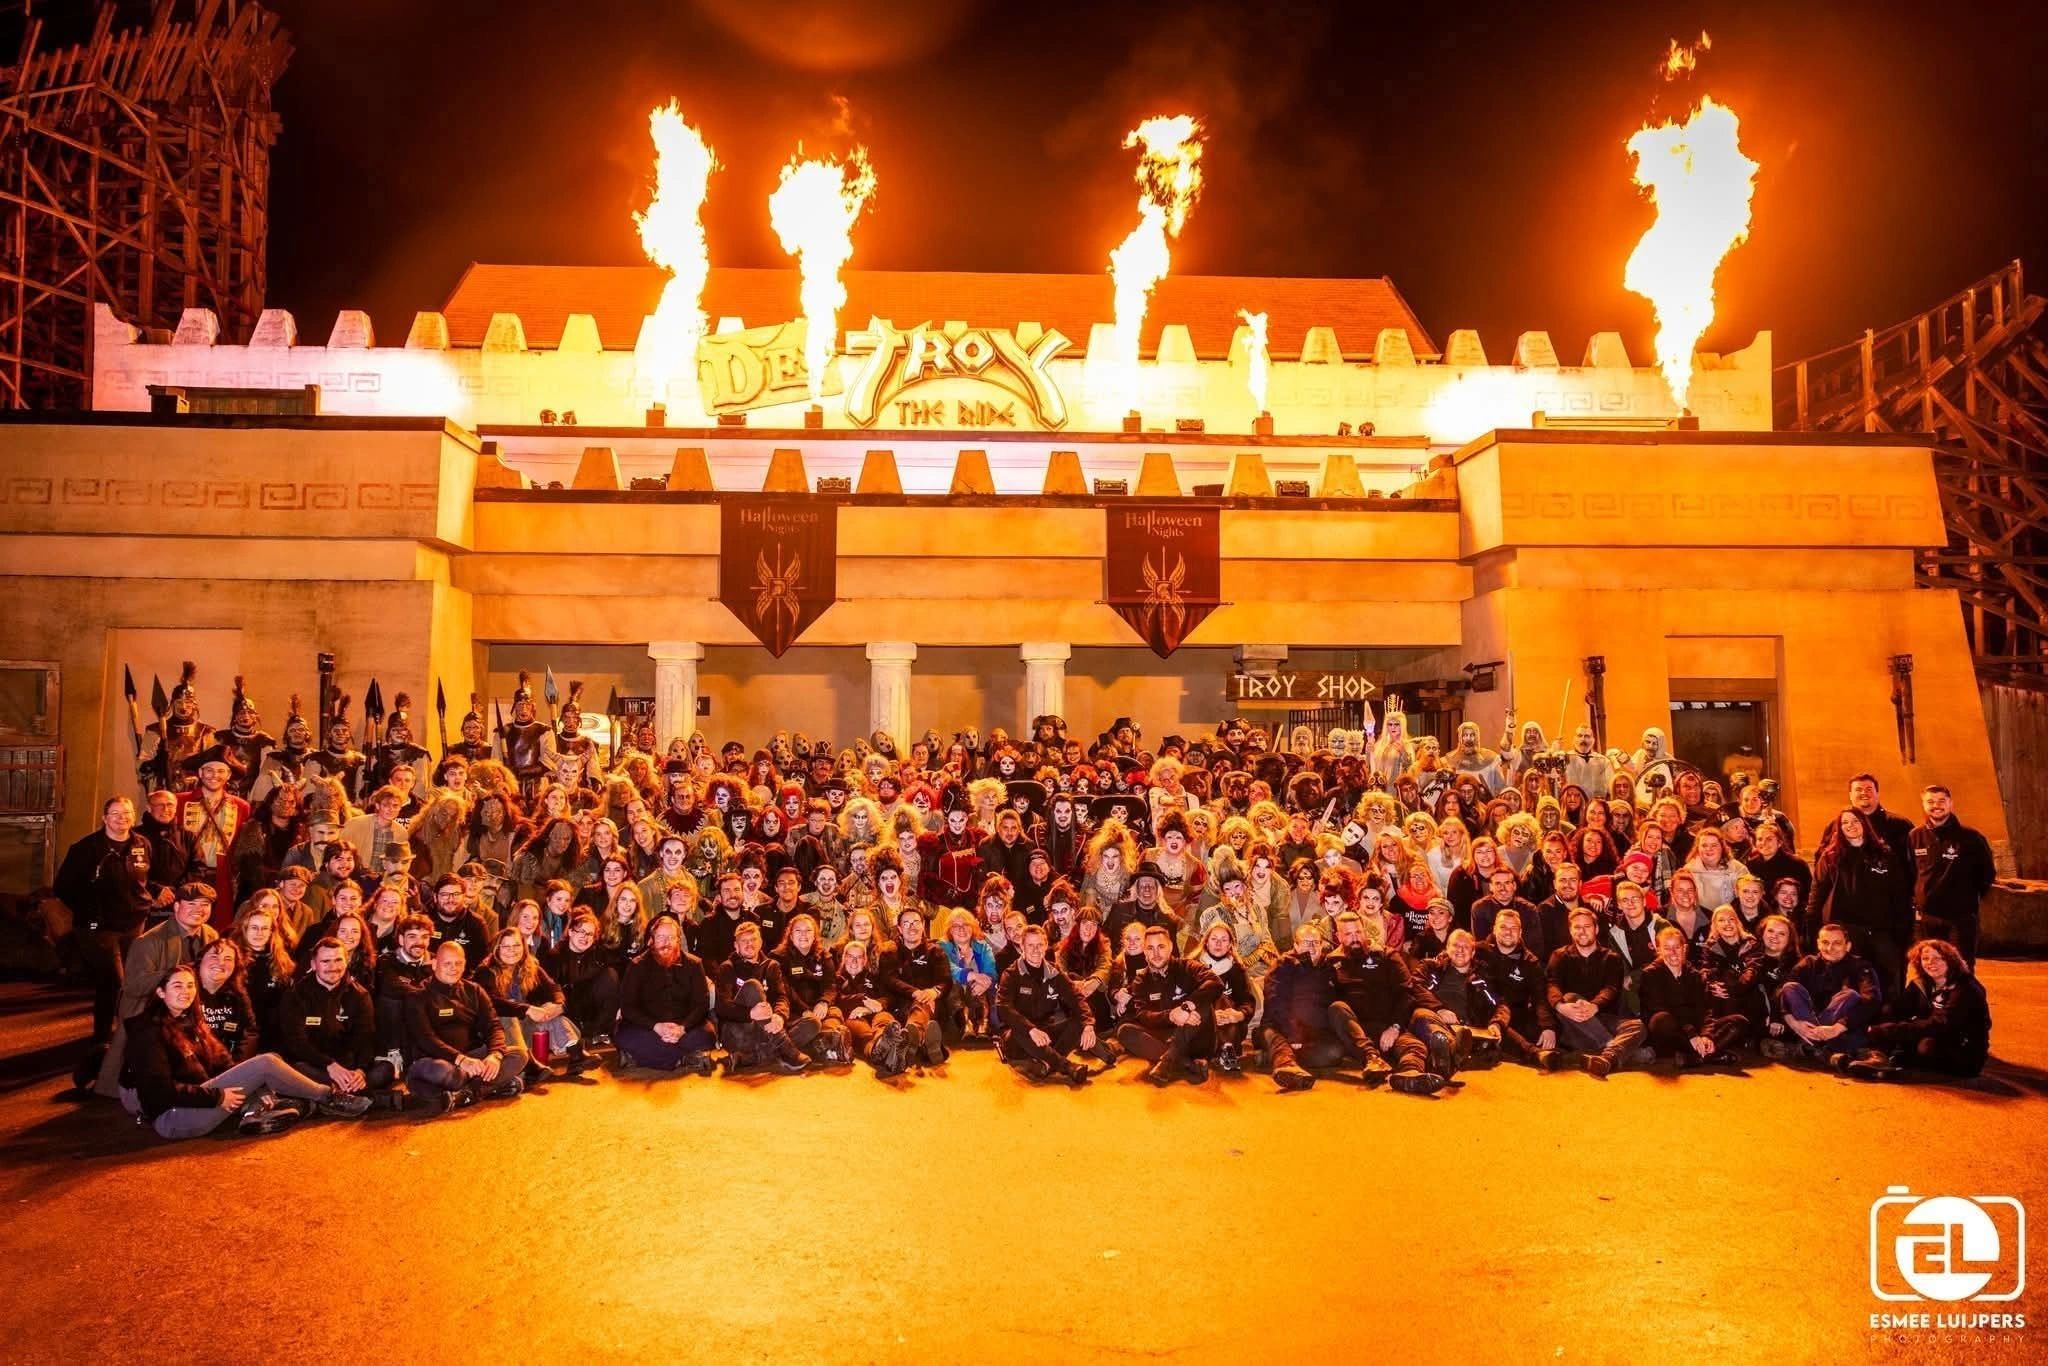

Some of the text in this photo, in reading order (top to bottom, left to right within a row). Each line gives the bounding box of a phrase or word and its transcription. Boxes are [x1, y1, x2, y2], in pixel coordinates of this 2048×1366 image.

[845, 314, 1073, 431] TROY
[895, 400, 1016, 427] THE RIDE
[740, 506, 818, 530] Halloween
[767, 524, 800, 535] Nights
[1126, 510, 1202, 534] Halloween
[1151, 526, 1184, 538] Nights
[1236, 674, 1376, 698] TROY SHOP
